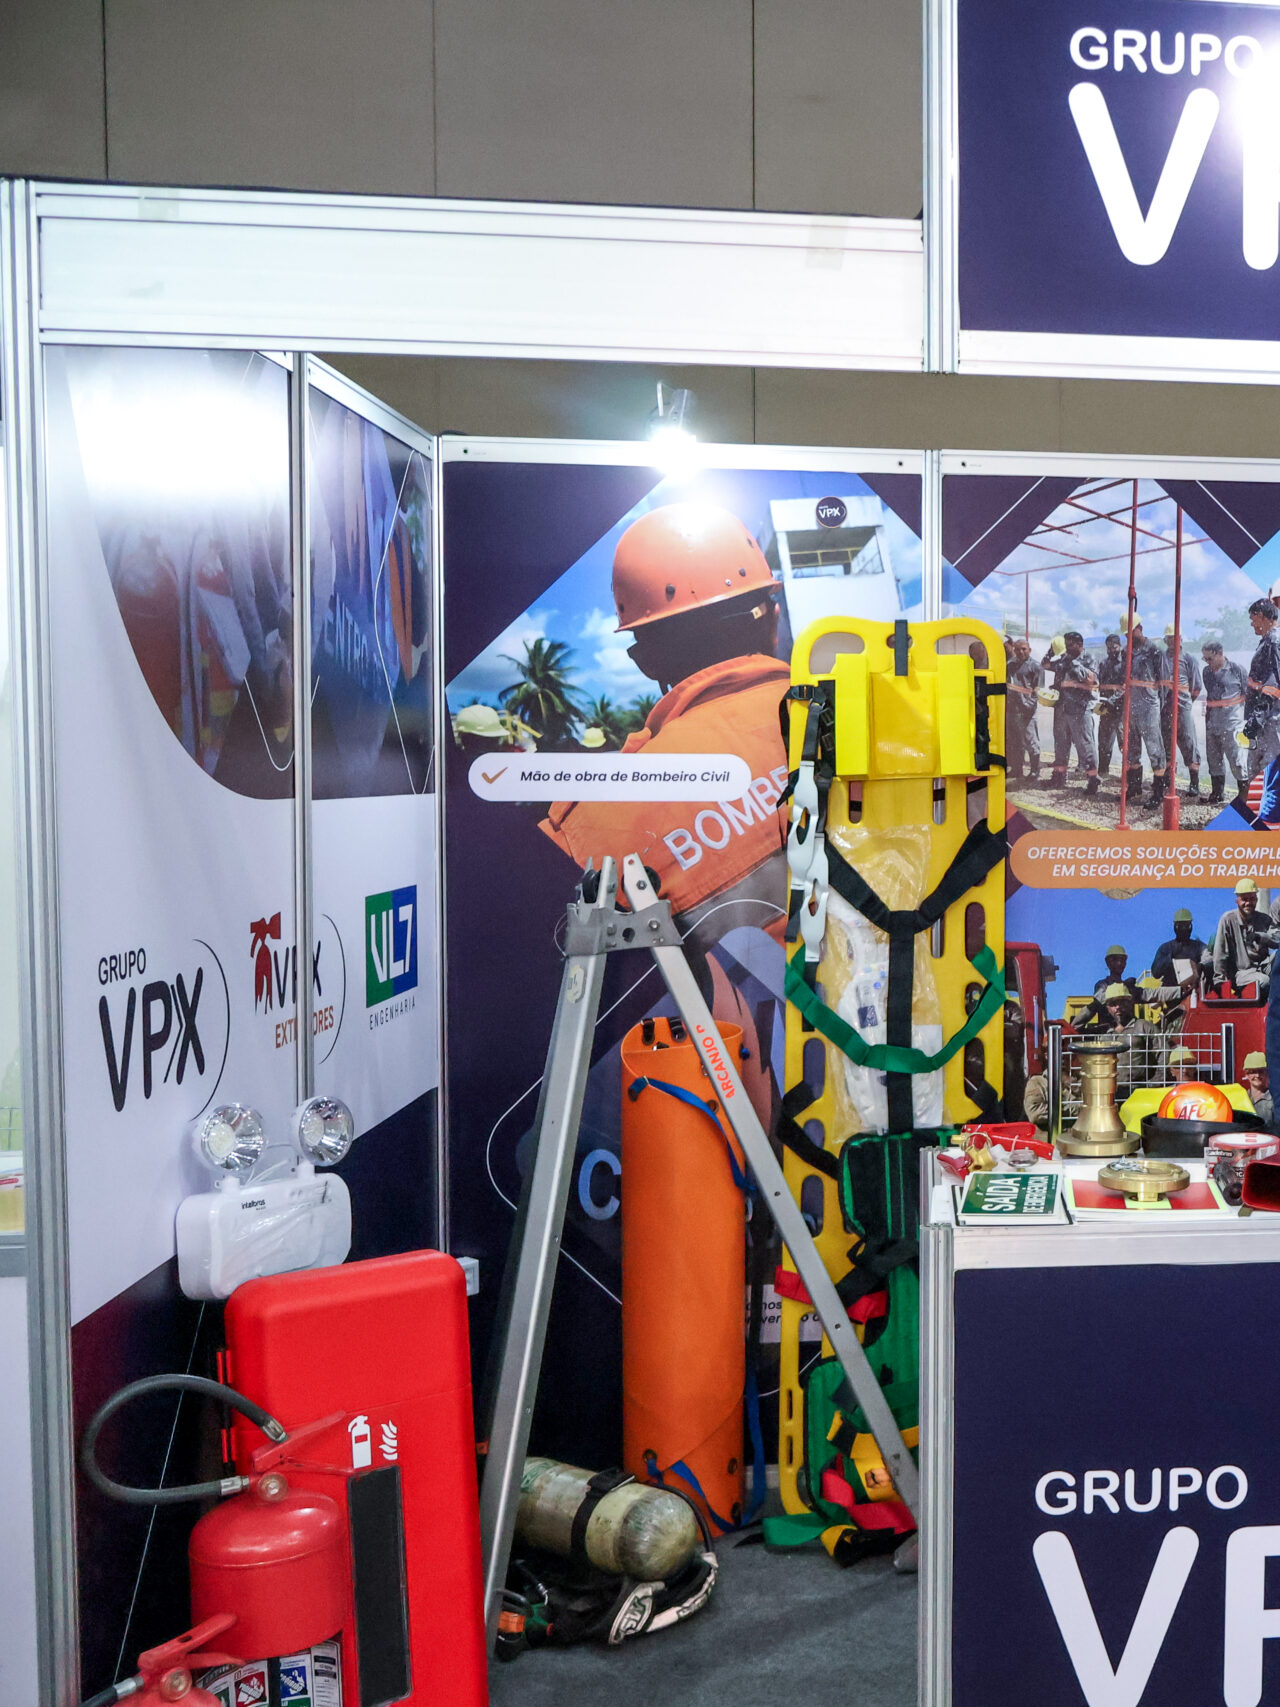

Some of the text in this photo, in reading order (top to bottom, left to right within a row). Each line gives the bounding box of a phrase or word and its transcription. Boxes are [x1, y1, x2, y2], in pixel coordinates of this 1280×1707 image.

[1069, 26, 1262, 77] GRUPO
[818, 507, 841, 519] VPX
[520, 771, 730, 782] Mão de obra de Bombeiro Civil
[1027, 847, 1132, 860] OFERECEMOS
[1136, 844, 1218, 863] SOLUÇÕES
[1052, 864, 1076, 877] EM
[1079, 864, 1176, 880] SEGURANÇA
[1180, 864, 1204, 877] DO
[370, 903, 414, 984] VL7
[98, 948, 147, 985] GRUPO
[369, 996, 416, 1031] ENGENHARIA
[98, 967, 205, 1112] VPX
[702, 1036, 736, 1099] ARCANJO
[976, 1177, 1022, 1212] SAÍDA
[1034, 1465, 1249, 1516] GRUPO
